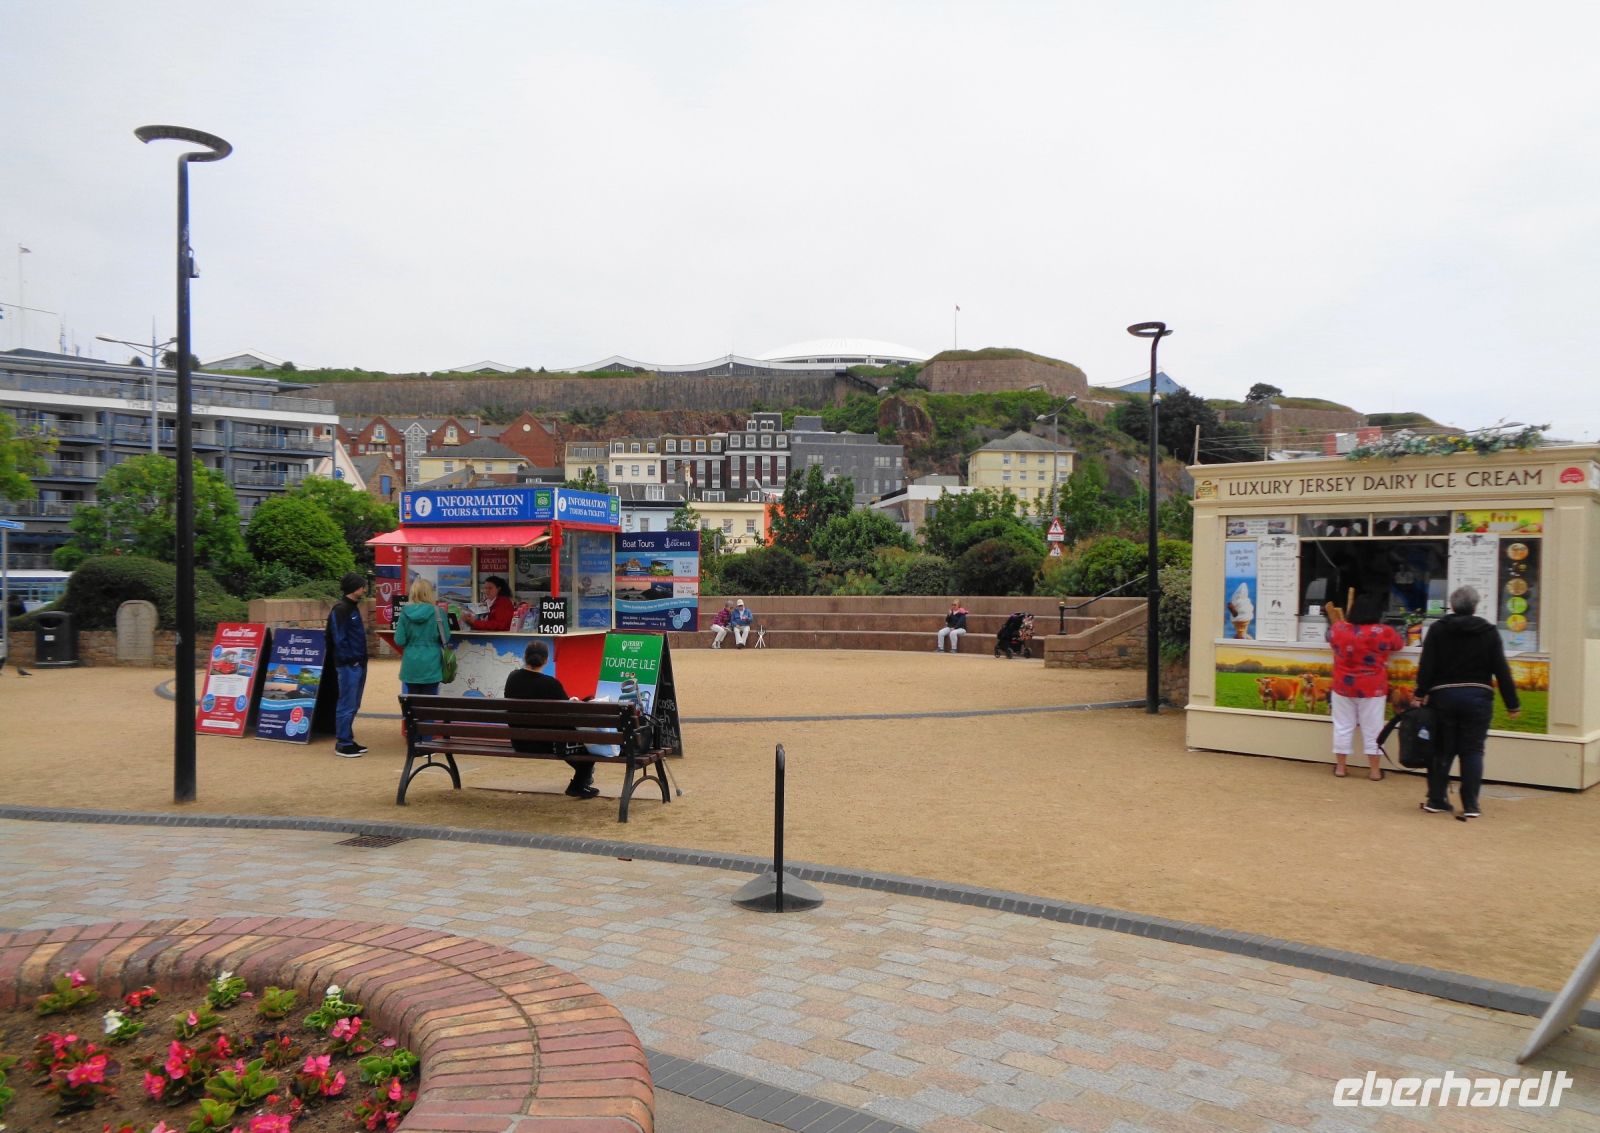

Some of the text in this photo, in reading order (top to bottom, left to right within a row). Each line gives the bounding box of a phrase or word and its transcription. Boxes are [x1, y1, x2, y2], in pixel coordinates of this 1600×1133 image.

[1229, 479, 1293, 497] LUXURY
[1299, 476, 1356, 496] JERSEY
[1363, 473, 1418, 491] DAIRY
[1425, 472, 1456, 488] ICE
[1465, 469, 1543, 488] CREAM
[436, 494, 524, 507] INFORMATION
[567, 496, 607, 509] INFORMATION
[441, 506, 519, 517] TOURS & TICKETS
[569, 507, 582, 516] TOURS
[622, 540, 655, 548] Boat Tours
[542, 611, 565, 619] TOUR
[539, 624, 565, 634] 14:00
[277, 646, 319, 656] Daily Boat Tours
[605, 657, 626, 668] TOUR
[626, 659, 637, 669] DE
